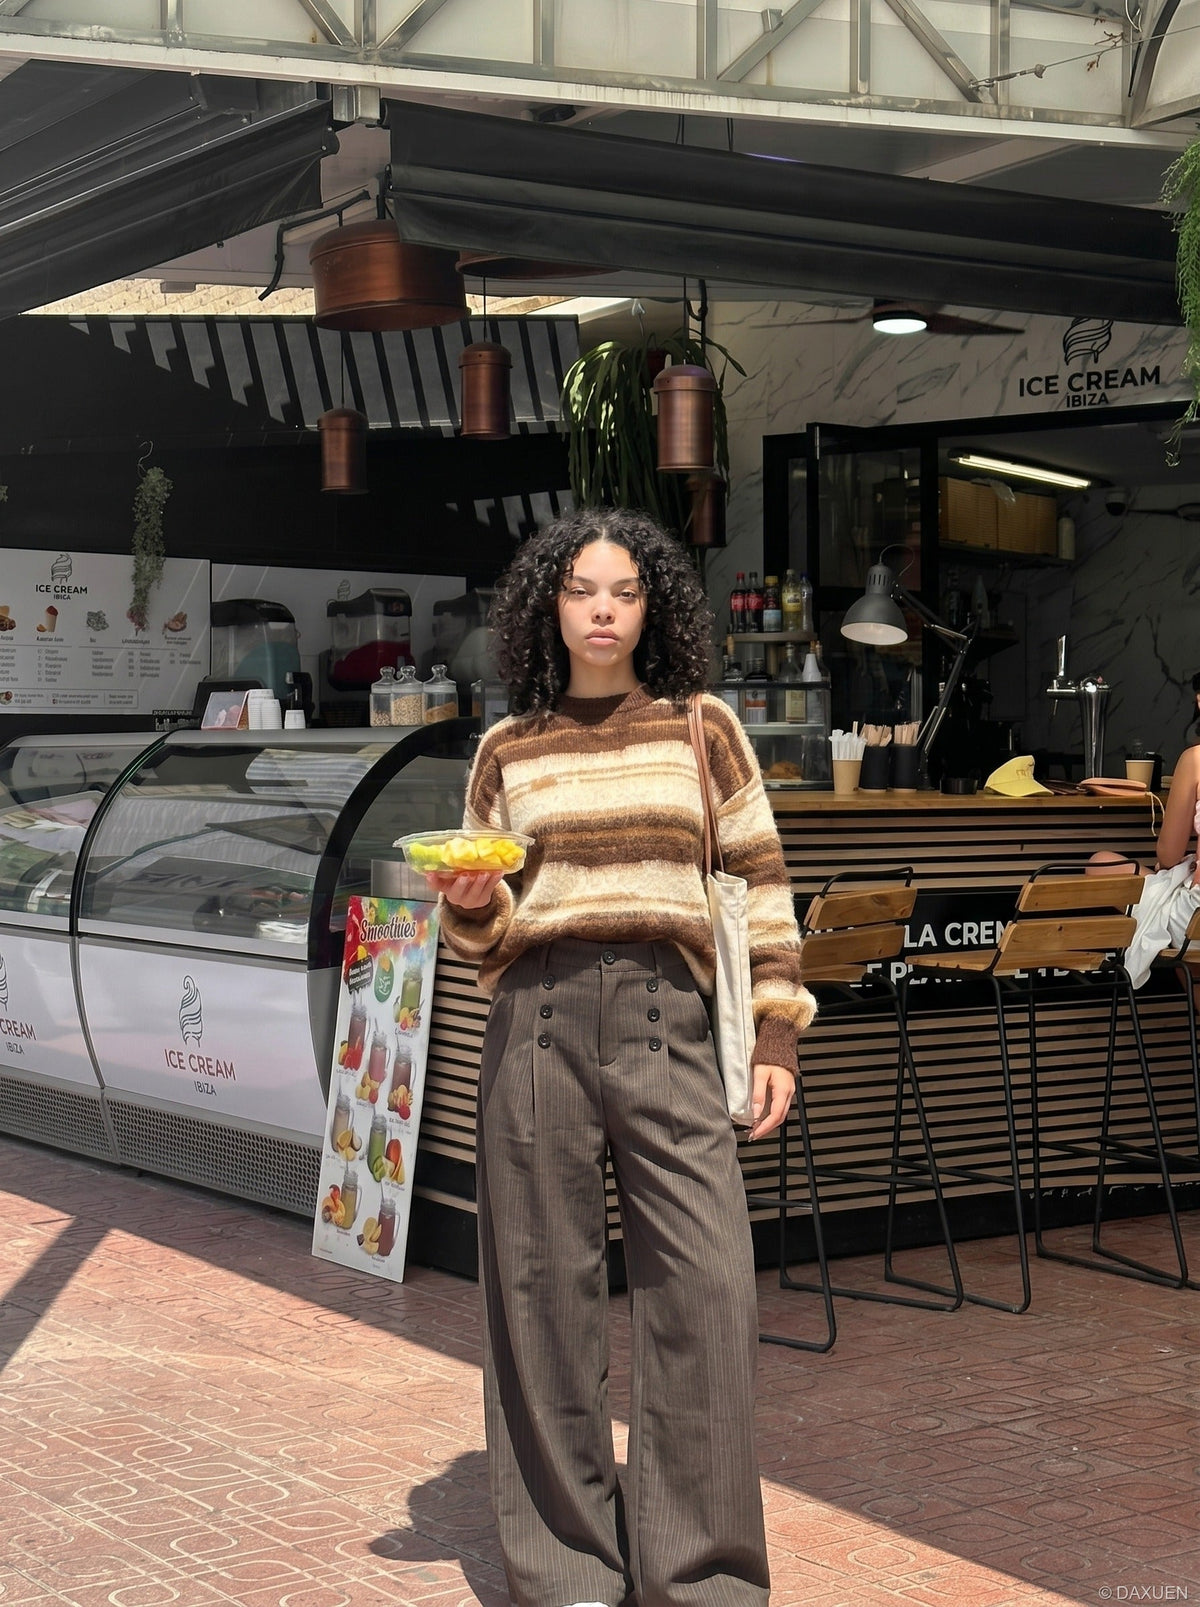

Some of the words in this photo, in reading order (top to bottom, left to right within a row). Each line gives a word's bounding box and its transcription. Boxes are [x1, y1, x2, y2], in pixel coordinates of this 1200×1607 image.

[1019, 375, 1059, 397] ICE
[1067, 365, 1161, 392] CREAM
[1066, 392, 1109, 408] IBIZA
[35, 584, 51, 593] ICE
[53, 585, 88, 594] CREAM
[904, 924, 938, 948] LA
[0, 1018, 37, 1041] CREAM
[164, 1048, 186, 1071] ICE
[188, 1053, 236, 1081] CREAM
[194, 1080, 217, 1096] IBIZA
